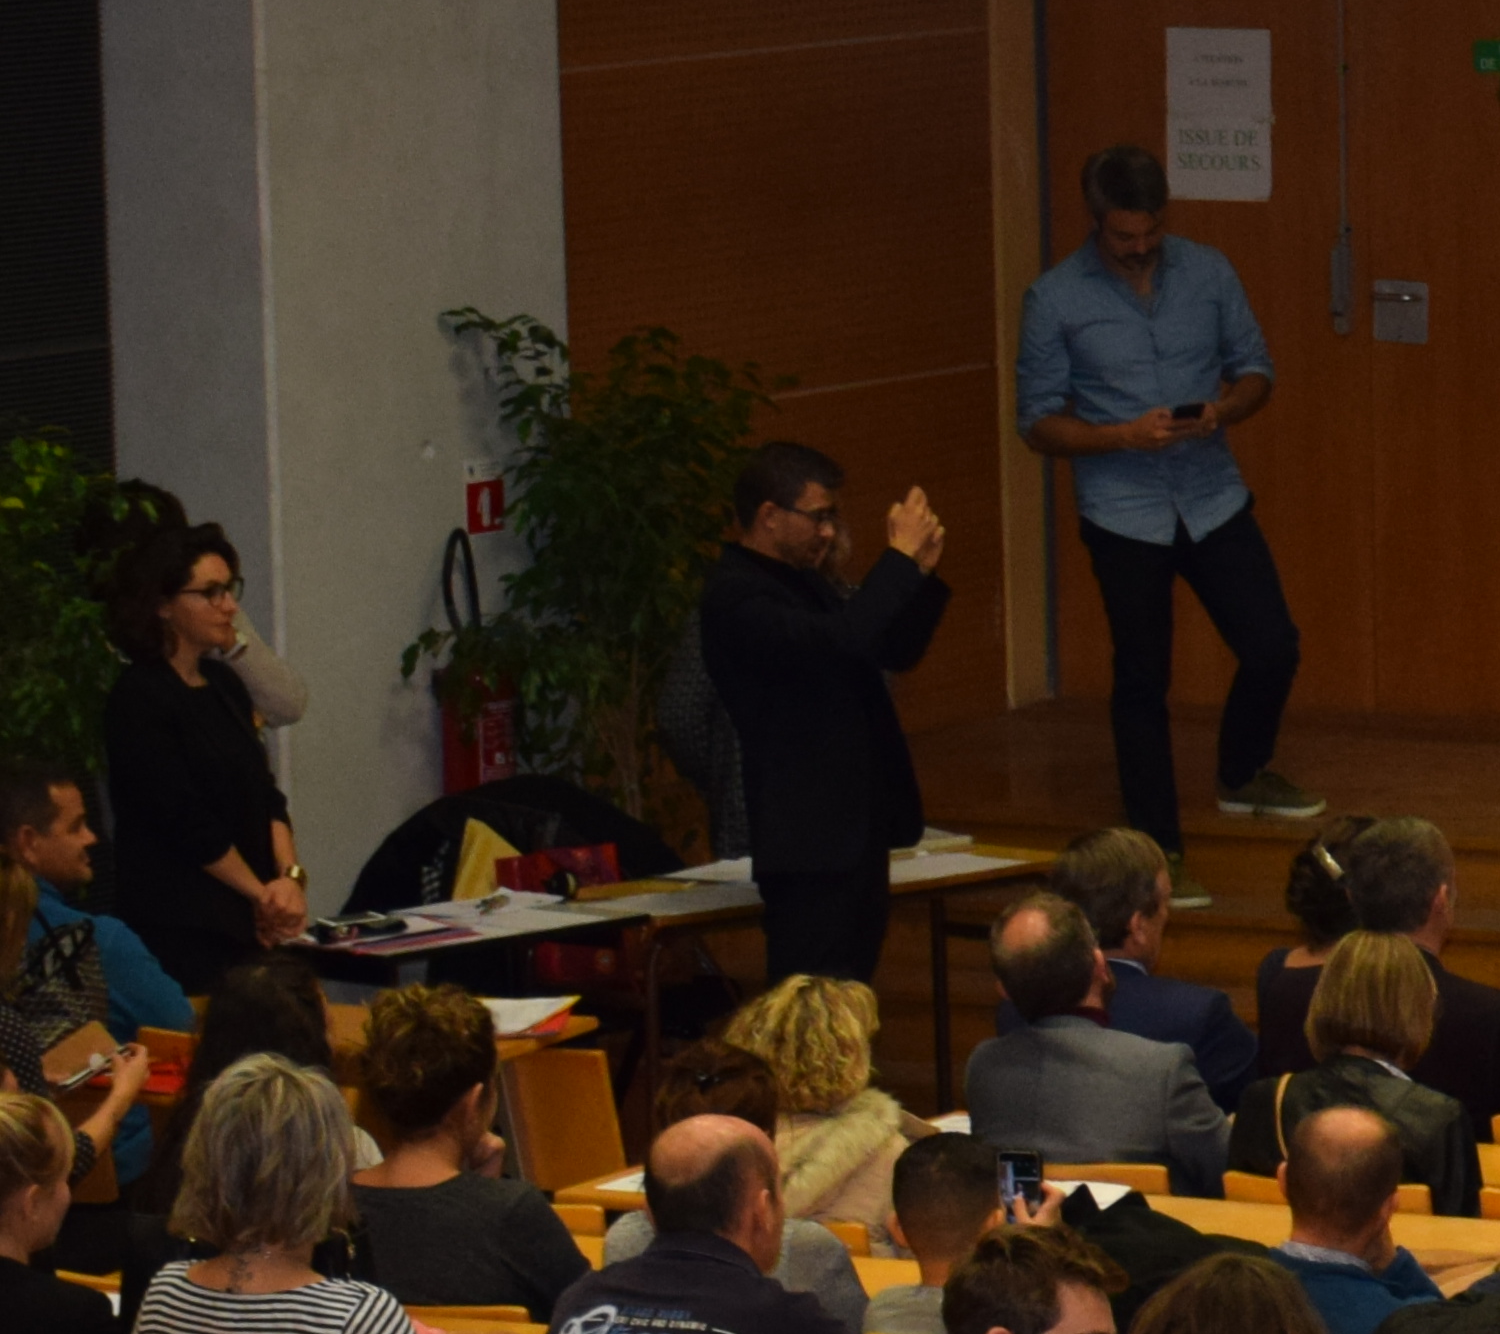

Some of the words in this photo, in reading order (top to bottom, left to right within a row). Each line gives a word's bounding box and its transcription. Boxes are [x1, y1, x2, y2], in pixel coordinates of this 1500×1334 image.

[1178, 128, 1228, 147] ISSUE
[1232, 128, 1258, 147] DE
[1177, 151, 1261, 171] SECOURS
